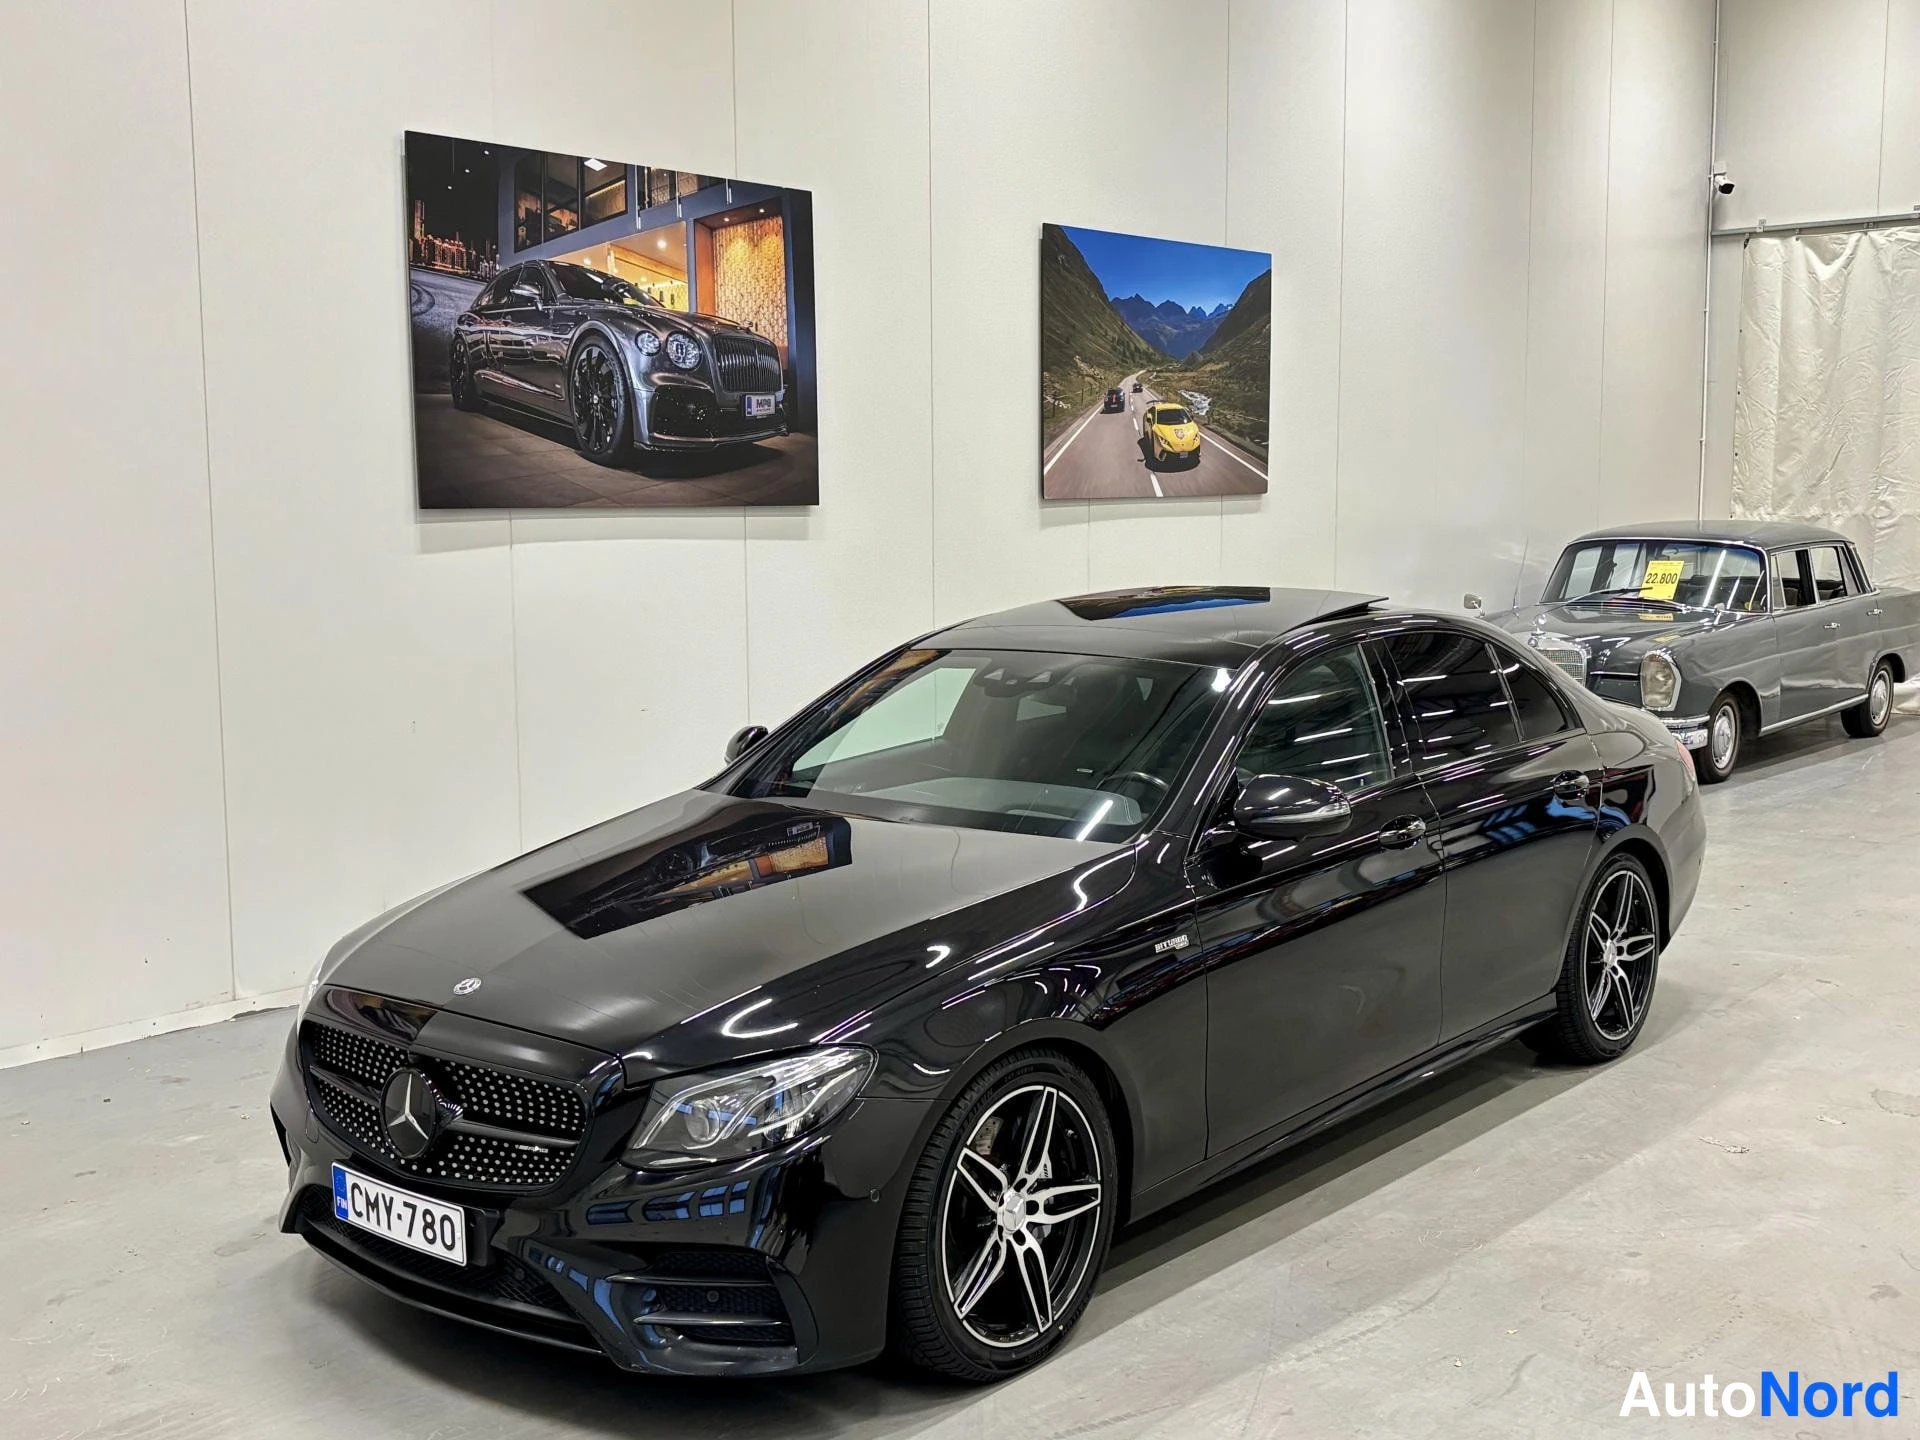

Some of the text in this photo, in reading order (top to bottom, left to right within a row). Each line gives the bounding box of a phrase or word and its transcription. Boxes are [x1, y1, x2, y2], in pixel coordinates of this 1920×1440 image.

[1645, 573, 1678, 584] 22.800
[337, 1196, 348, 1210] FIN
[351, 1183, 456, 1251] CMY-780
